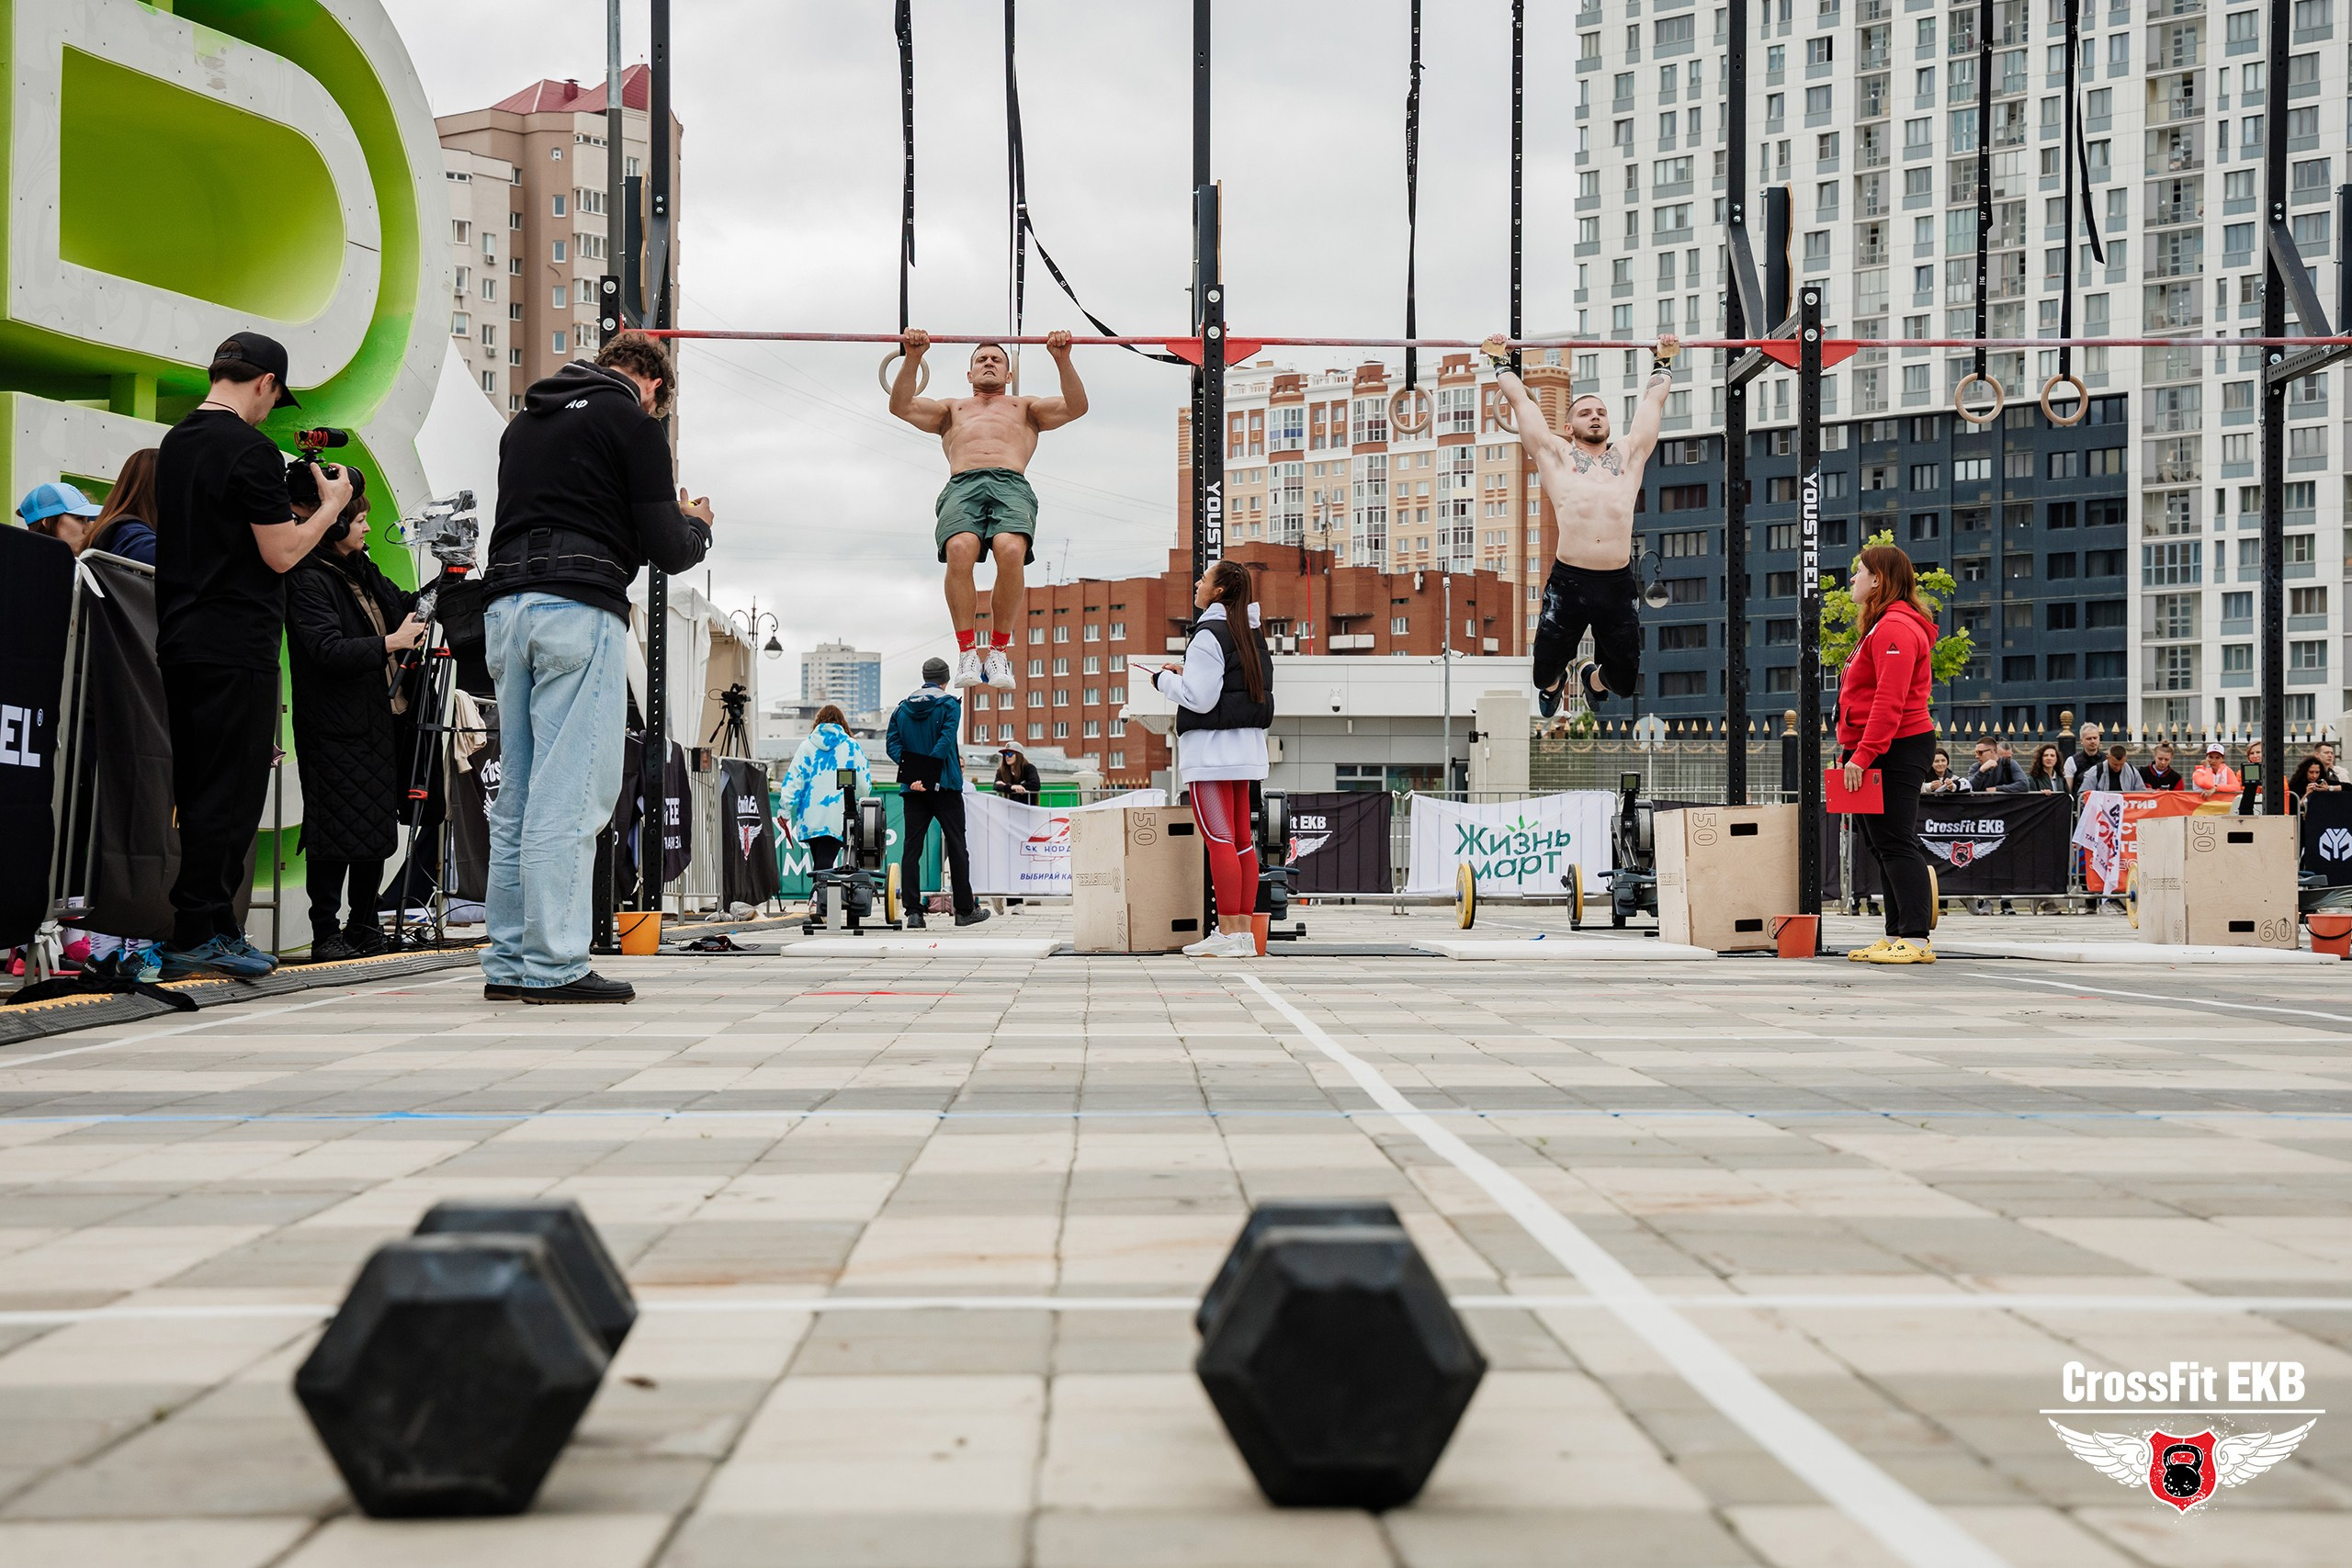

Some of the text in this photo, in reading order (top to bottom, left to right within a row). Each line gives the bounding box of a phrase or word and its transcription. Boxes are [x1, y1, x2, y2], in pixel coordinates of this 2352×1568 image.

[1804, 472, 1818, 599] YOUSTEEL
[0, 704, 41, 768] EL
[1133, 811, 1157, 846] 50
[1300, 815, 1327, 829] EKB
[1692, 812, 1718, 846] 50
[1925, 818, 2005, 834] CrossFit EKB
[2192, 820, 2216, 853] 50
[1453, 823, 1571, 855] Жизнь
[1020, 872, 1060, 880] ВЫБИРАЙ
[1468, 851, 1562, 885] март
[2259, 919, 2292, 942] 60
